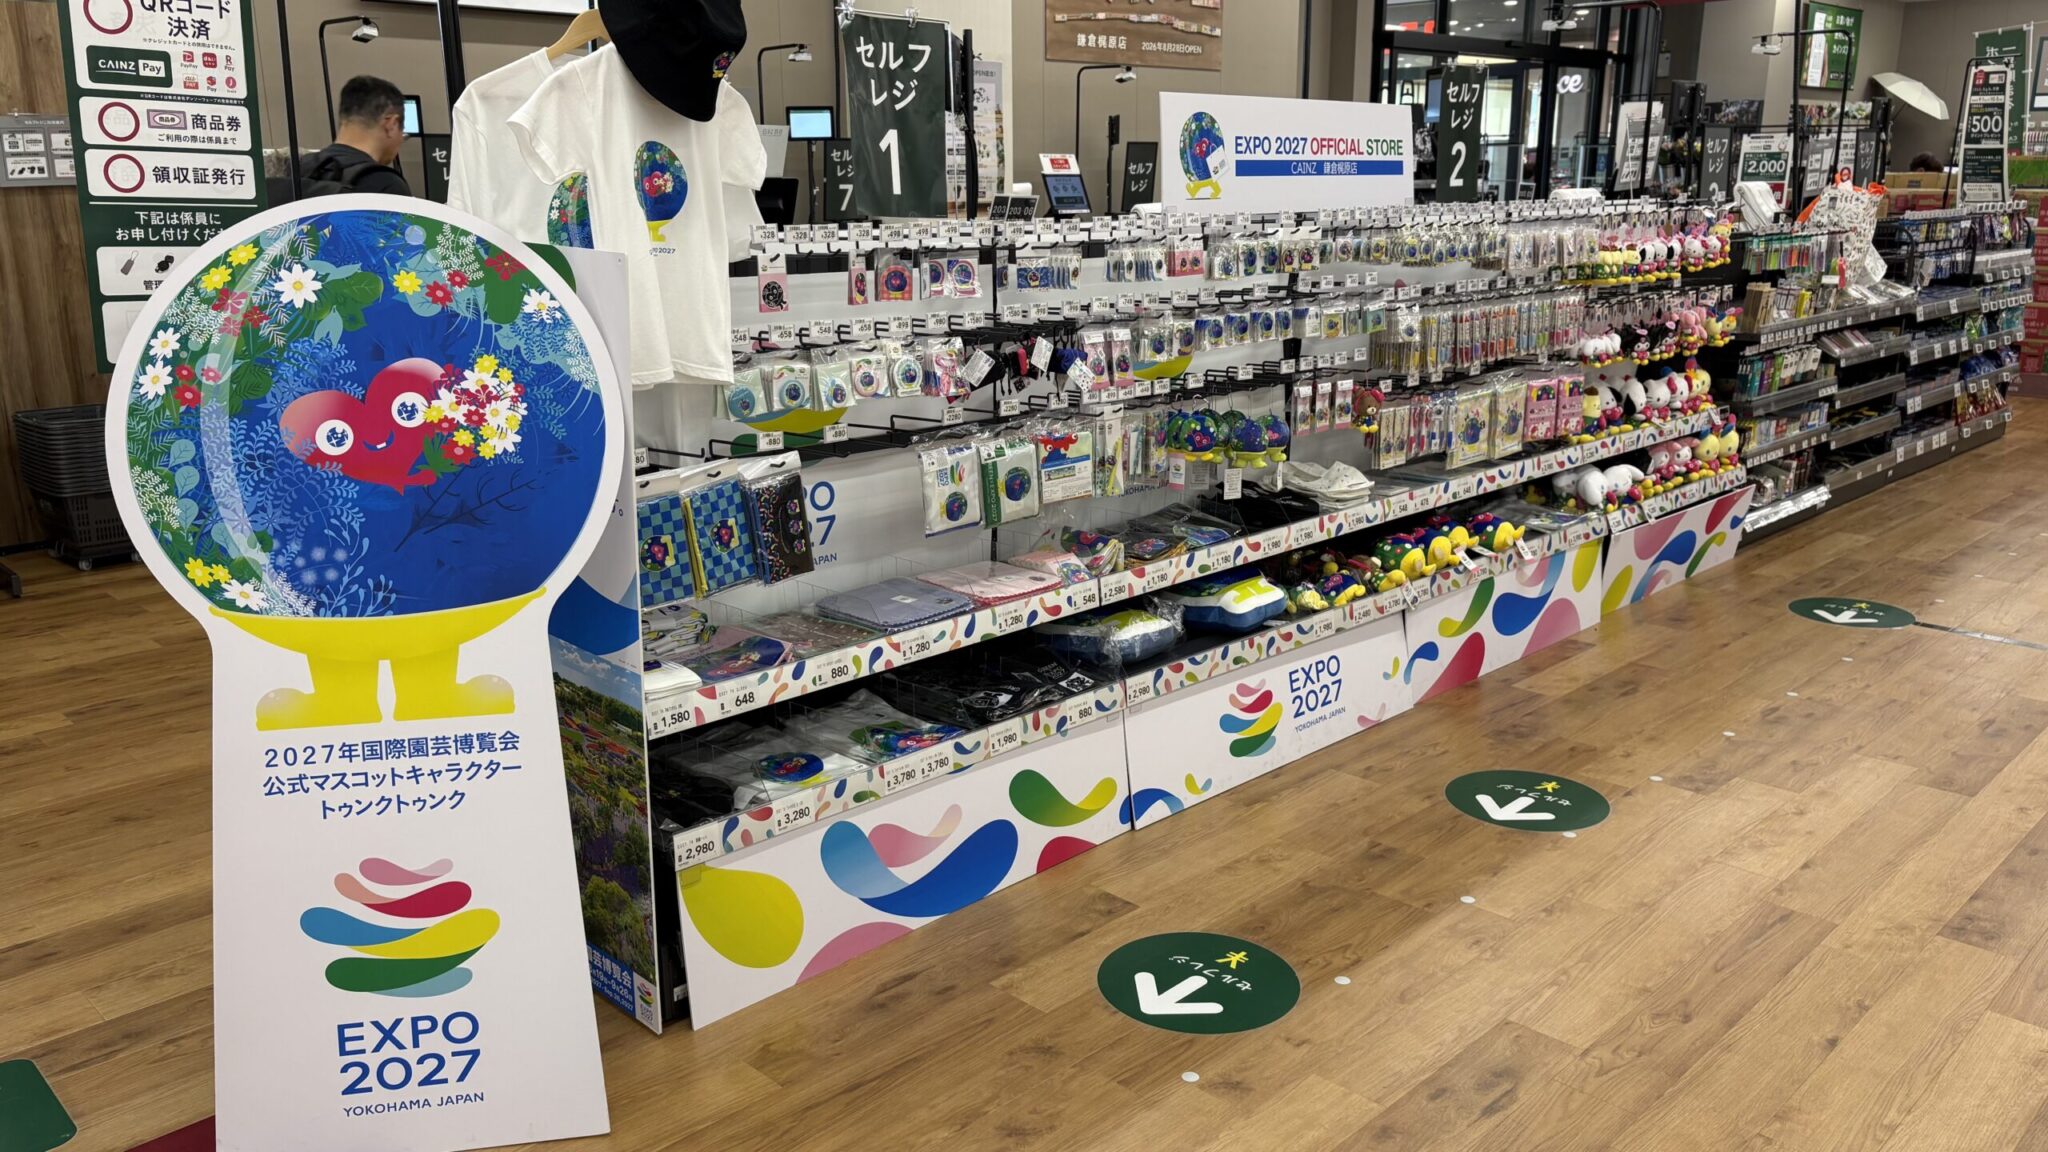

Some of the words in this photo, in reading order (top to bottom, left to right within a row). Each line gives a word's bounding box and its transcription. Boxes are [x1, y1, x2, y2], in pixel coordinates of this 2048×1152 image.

[168, 16, 211, 41] 決済
[1076, 33, 1127, 49] 鎌倉梶原店
[855, 36, 932, 73] セルフ
[98, 59, 136, 71] CAINZ
[142, 63, 161, 75] Pay
[870, 78, 918, 111] レジ
[1446, 81, 1480, 103] セルフ
[191, 113, 242, 132] 商品券
[1450, 107, 1474, 130] レジ
[1971, 115, 2002, 133] 500
[157, 133, 237, 145] ご利用の際は係員まで
[1235, 136, 1271, 155] EXPO
[1275, 136, 1307, 155] 2027
[1311, 137, 1364, 155] OFFICIAL
[1366, 138, 1403, 156] STORE
[1706, 138, 1728, 154] セルフ
[1859, 140, 1875, 154] セルフ
[879, 129, 901, 195] 1
[1128, 162, 1153, 175] セルフ
[1291, 161, 1317, 175] CAINZ
[1323, 161, 1358, 175] 鎌倉梶原店
[1449, 141, 1466, 187] 2
[1708, 157, 1724, 173] レジ
[1747, 160, 1786, 173] 2,000
[1860, 157, 1872, 169] レジ
[152, 165, 246, 186] 領収証発行
[1130, 179, 1148, 192] レジ
[838, 184, 854, 211] 7
[134, 211, 222, 225] 下記は係員に
[1265, 540, 1282, 552] 1,980
[1215, 554, 1231, 567] 1,180
[1150, 572, 1168, 587] 1,180
[1083, 594, 1097, 605] 548
[1108, 585, 1126, 598] 2,580
[1004, 614, 1024, 630] 1,280
[1317, 622, 1333, 635] 1,980
[908, 641, 931, 656] 1,280
[831, 664, 849, 680] 880
[1288, 654, 1341, 693] EXPO
[735, 692, 755, 707] 648
[1132, 686, 1151, 699] 2,980
[1292, 679, 1342, 719] 2027
[661, 710, 690, 728] 1,580
[1078, 707, 1092, 718] 880
[1295, 714, 1328, 733] YOKOHAMA
[1328, 706, 1346, 721] JAPAN
[996, 732, 1017, 748] 1,980
[264, 730, 520, 768] 2027年国際園芸博覧会
[926, 757, 949, 773] 3,780
[263, 759, 522, 797] 公式マスコットキャラクター
[893, 768, 916, 785] 3,780
[1496, 784, 1572, 807] セルフレジ
[320, 790, 465, 820] トゥンクトゥンク
[784, 807, 811, 824] 3,280
[685, 841, 715, 860] 2,980
[1168, 954, 1252, 991] セルフレジ
[336, 1011, 480, 1057] EXPO
[341, 1048, 481, 1096] 2027
[343, 1098, 431, 1118] YOKOHAMA
[437, 1091, 485, 1109] JAPAN
